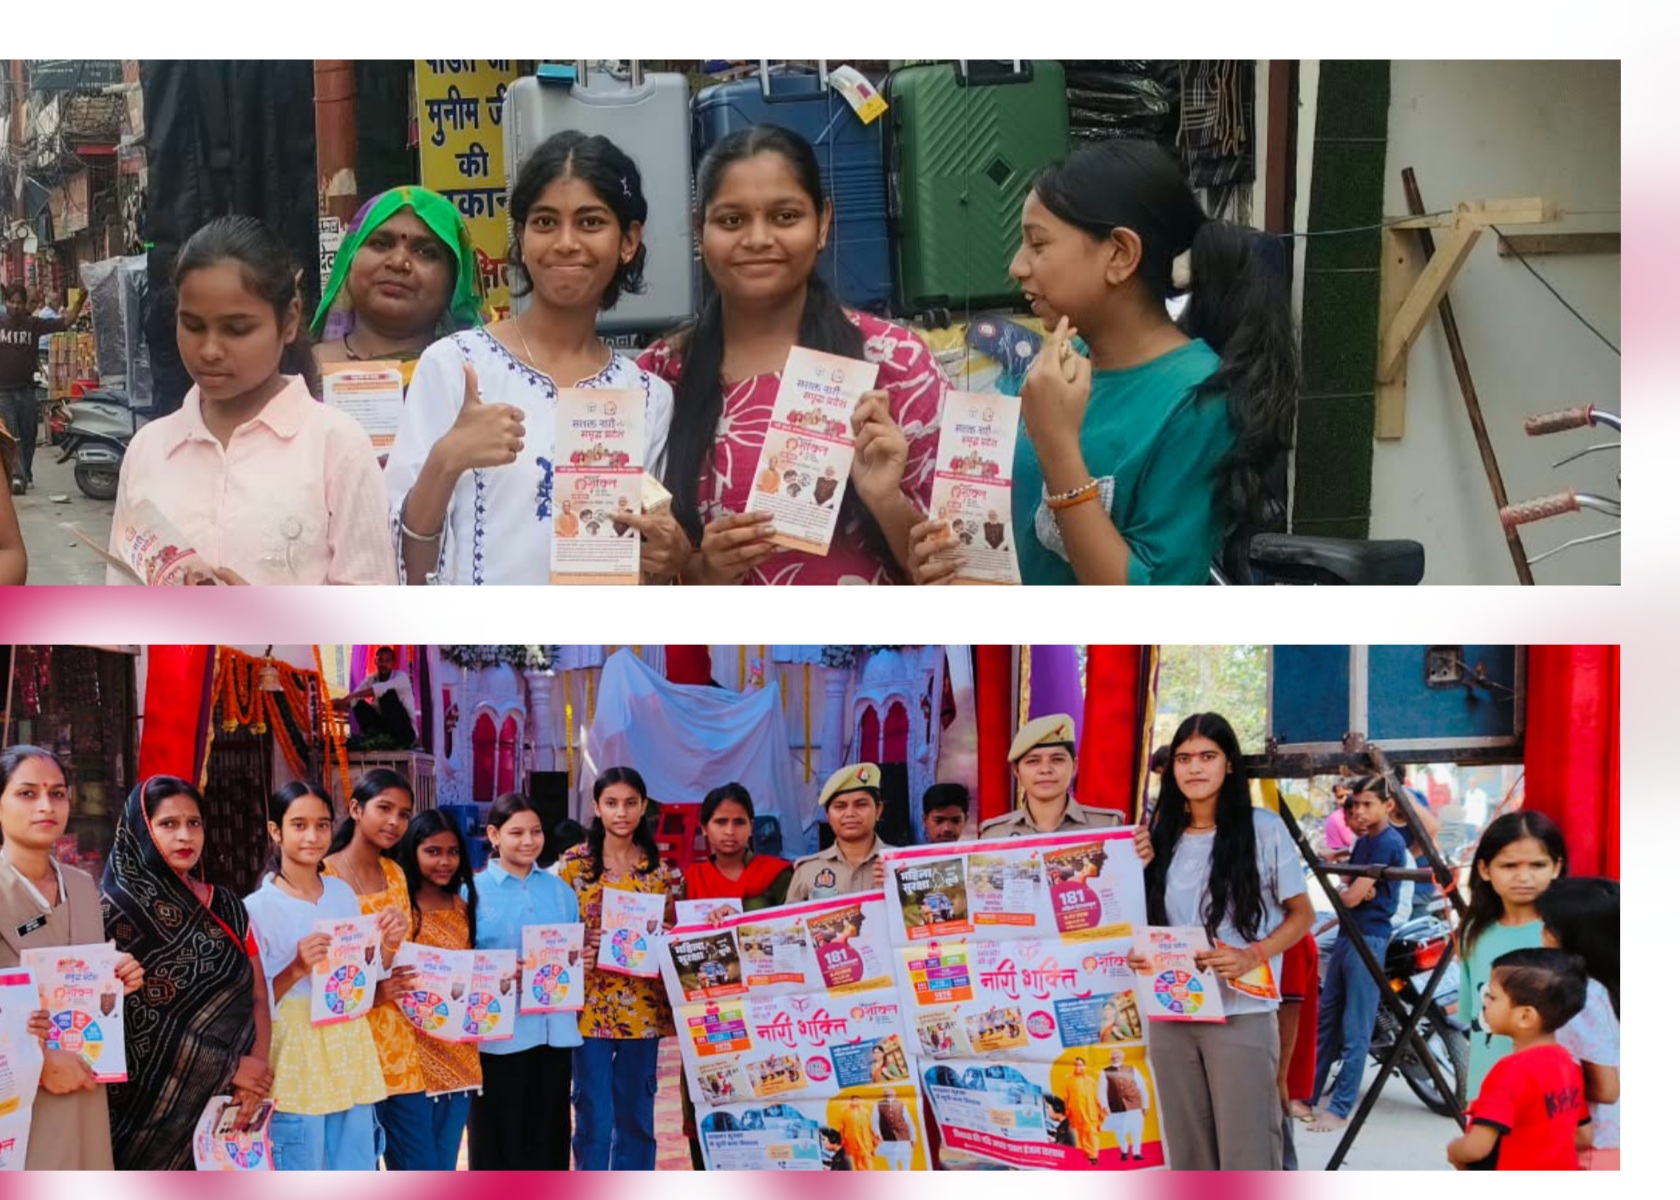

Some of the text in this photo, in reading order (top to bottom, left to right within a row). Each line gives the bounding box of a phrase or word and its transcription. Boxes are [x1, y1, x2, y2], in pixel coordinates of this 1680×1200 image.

[425, 85, 478, 146] मुनीम
[455, 142, 489, 178] की
[1058, 889, 1086, 906] 181
[824, 948, 847, 964] 181
[979, 957, 1092, 1000] नारी शक्ति
[755, 1011, 798, 1049] नारी
[798, 1007, 862, 1047] शक्ति
